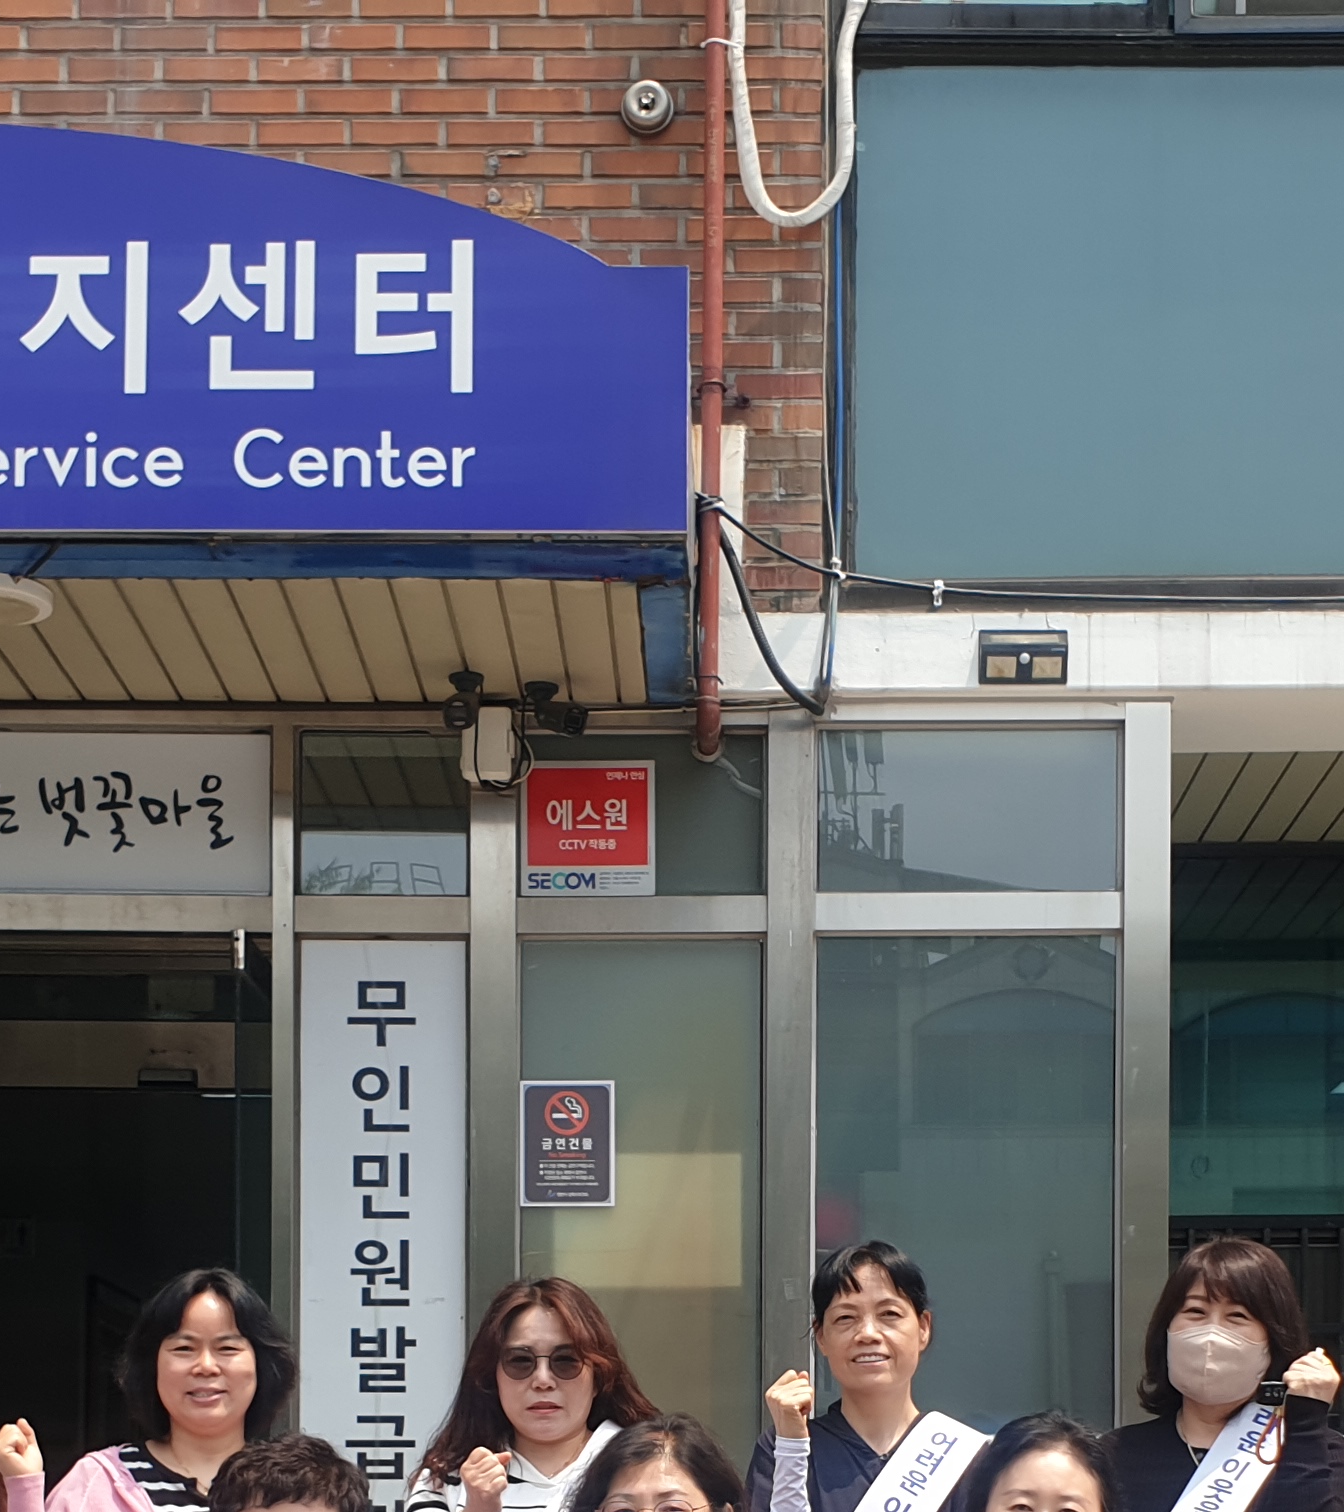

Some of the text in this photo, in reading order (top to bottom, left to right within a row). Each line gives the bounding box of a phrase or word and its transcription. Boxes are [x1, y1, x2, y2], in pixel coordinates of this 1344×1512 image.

[232, 428, 476, 489] Center
[38, 771, 235, 853] 벚꽃마을
[546, 798, 628, 831] 에스원
[559, 839, 587, 850] CCTV
[527, 872, 596, 890] SECOM
[900, 1431, 958, 1497] 어려운
